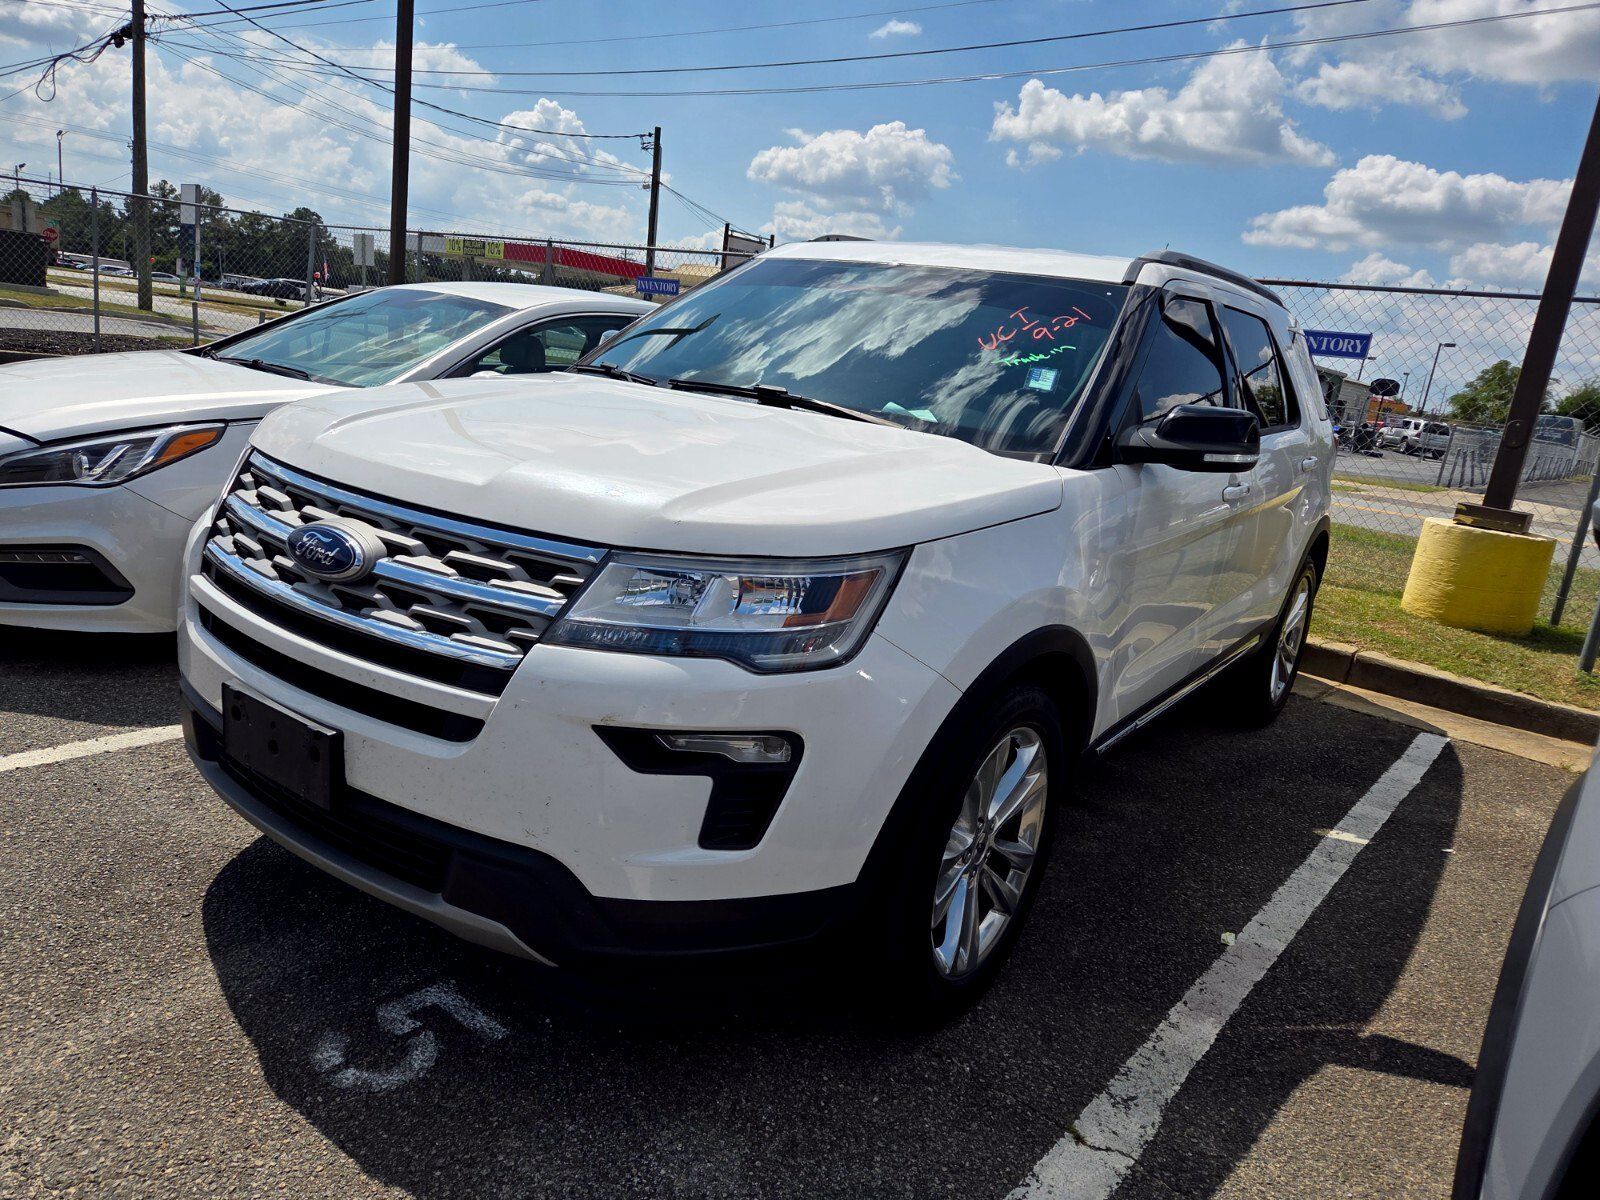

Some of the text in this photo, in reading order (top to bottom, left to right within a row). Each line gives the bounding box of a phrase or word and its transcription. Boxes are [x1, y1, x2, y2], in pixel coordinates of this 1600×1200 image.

[448, 239, 461, 251] 10%
[487, 242, 501, 255] 10%
[637, 280, 677, 293] INVENTORY
[1306, 335, 1366, 353] NTORY
[295, 531, 340, 565] Ford
